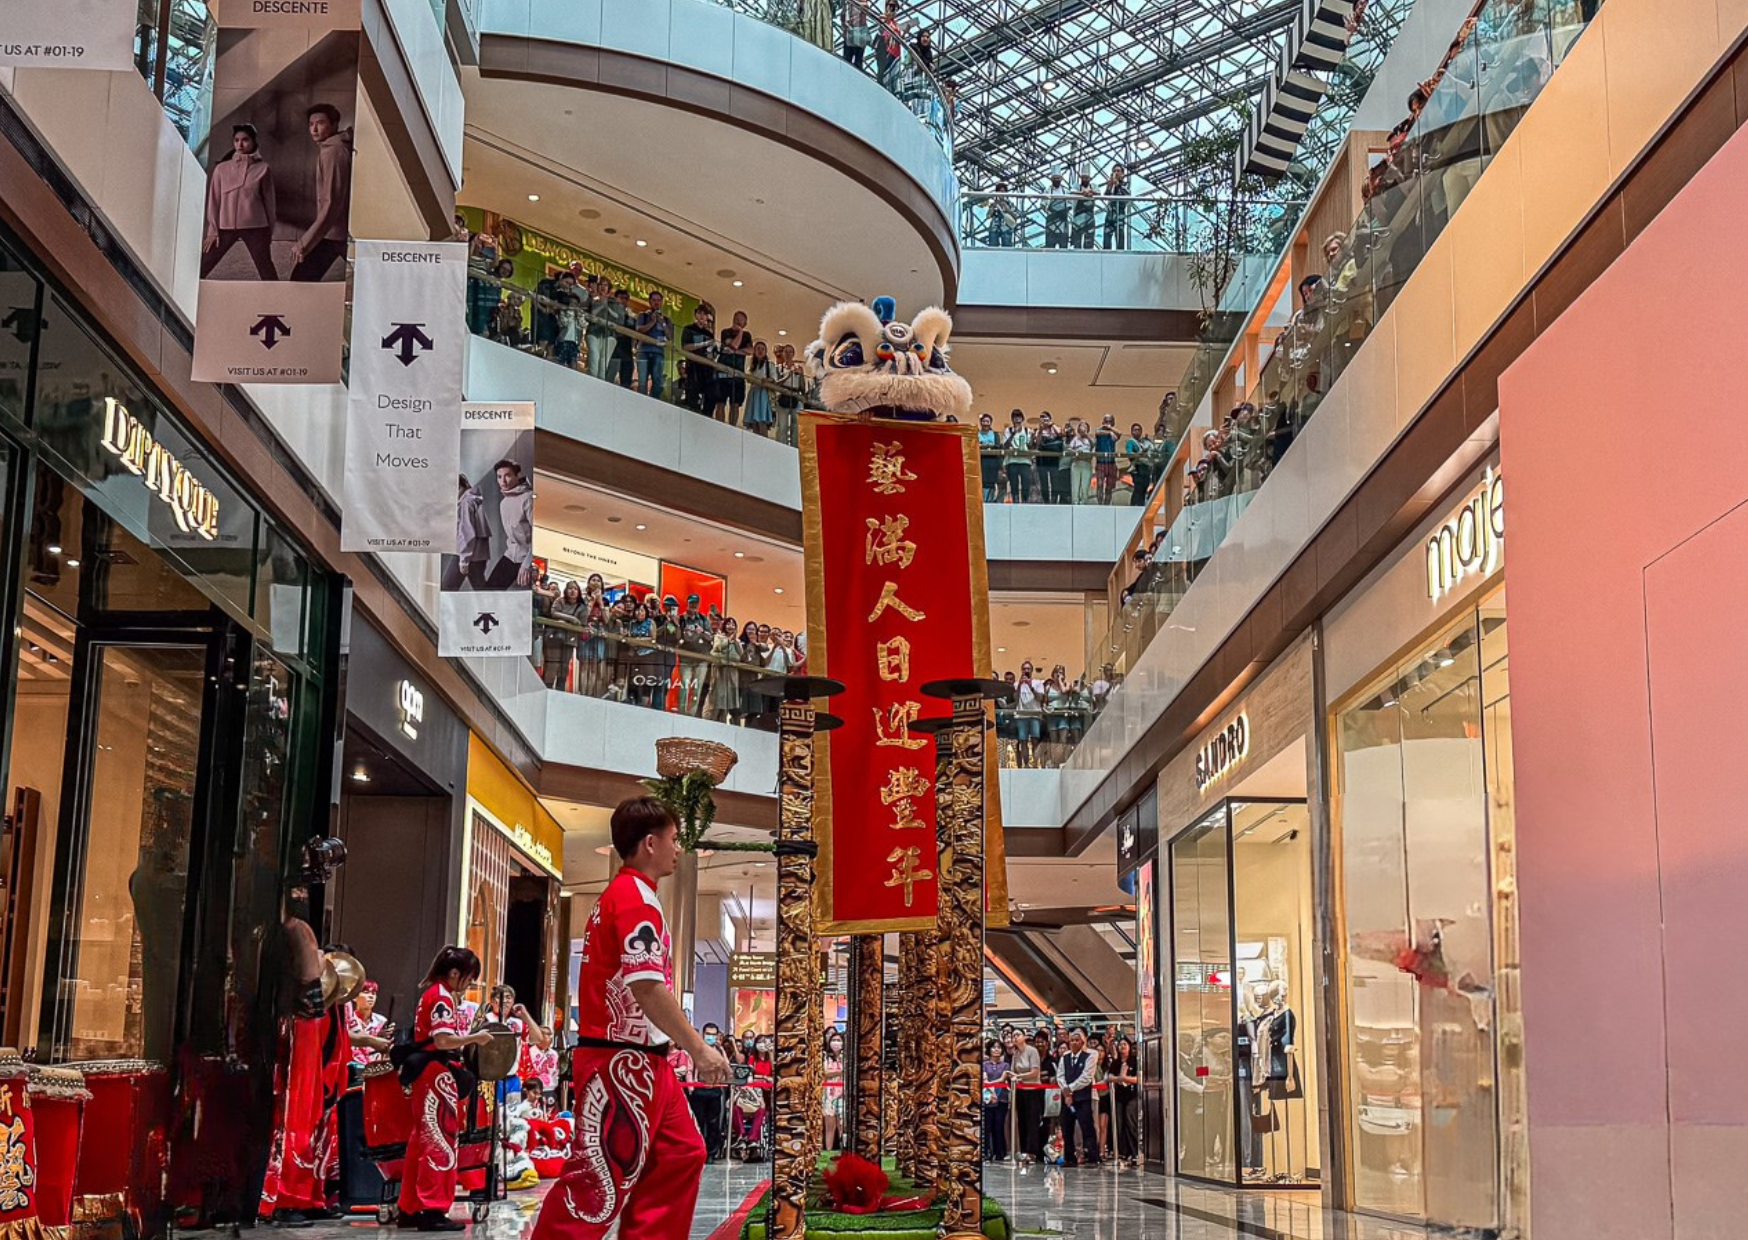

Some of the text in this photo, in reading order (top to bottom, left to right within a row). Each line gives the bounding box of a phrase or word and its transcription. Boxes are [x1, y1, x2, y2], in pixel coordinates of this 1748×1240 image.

[253, 0, 328, 14] DESCENTE
[4, 44, 84, 57] US AT #01-19
[382, 251, 441, 264] DESCENTE
[227, 367, 308, 376] VISIT US AT #01-19
[377, 393, 432, 413] Design
[465, 410, 513, 420] DESCENTE
[385, 422, 422, 439] That
[375, 452, 429, 468] Moves
[1426, 466, 1503, 602] maje
[366, 538, 386, 546] VISIT
[386, 538, 397, 546] US
[397, 538, 407, 546] AT
[1196, 713, 1247, 790] SANDRO
